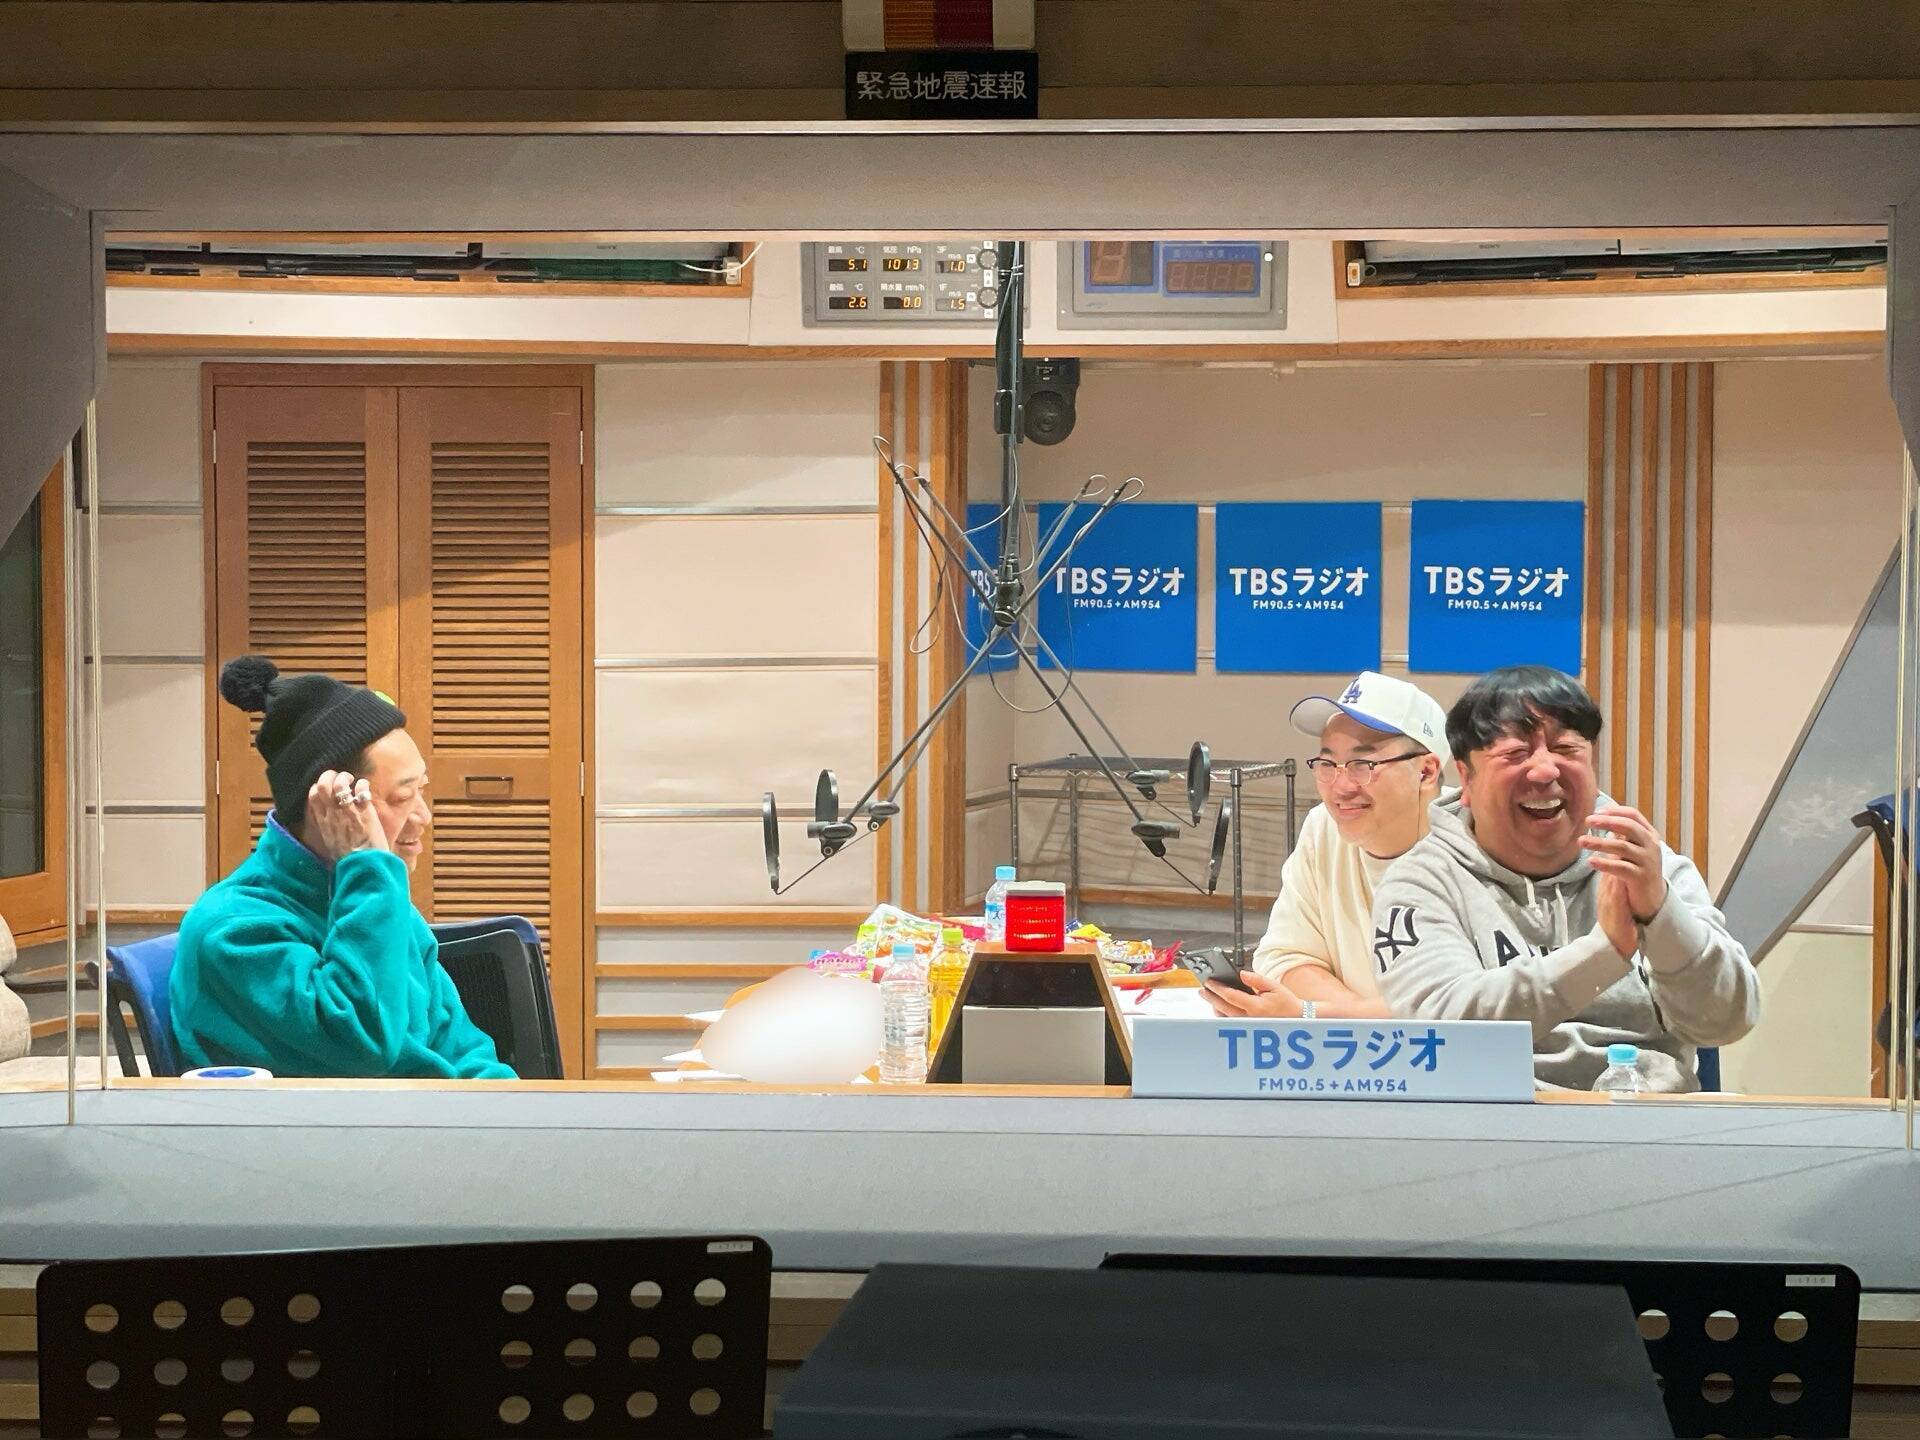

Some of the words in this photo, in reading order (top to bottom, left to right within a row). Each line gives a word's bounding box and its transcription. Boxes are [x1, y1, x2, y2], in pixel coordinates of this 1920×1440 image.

[856, 71, 1027, 100] 緊急地震速報
[848, 259, 867, 270] 5.1
[888, 259, 919, 270] 1013
[950, 260, 966, 272] 1.0
[848, 296, 867, 308] 2.6
[903, 296, 922, 308] 0.0
[950, 298, 965, 310] 1.5
[1055, 567, 1185, 596] TBSラジオ
[1229, 566, 1369, 596] TBSラジオ
[1423, 566, 1569, 597] TBSラジオ
[1218, 1028, 1446, 1072] TBSラジオ
[1258, 1077, 1408, 1092] FM90.5+AM954
